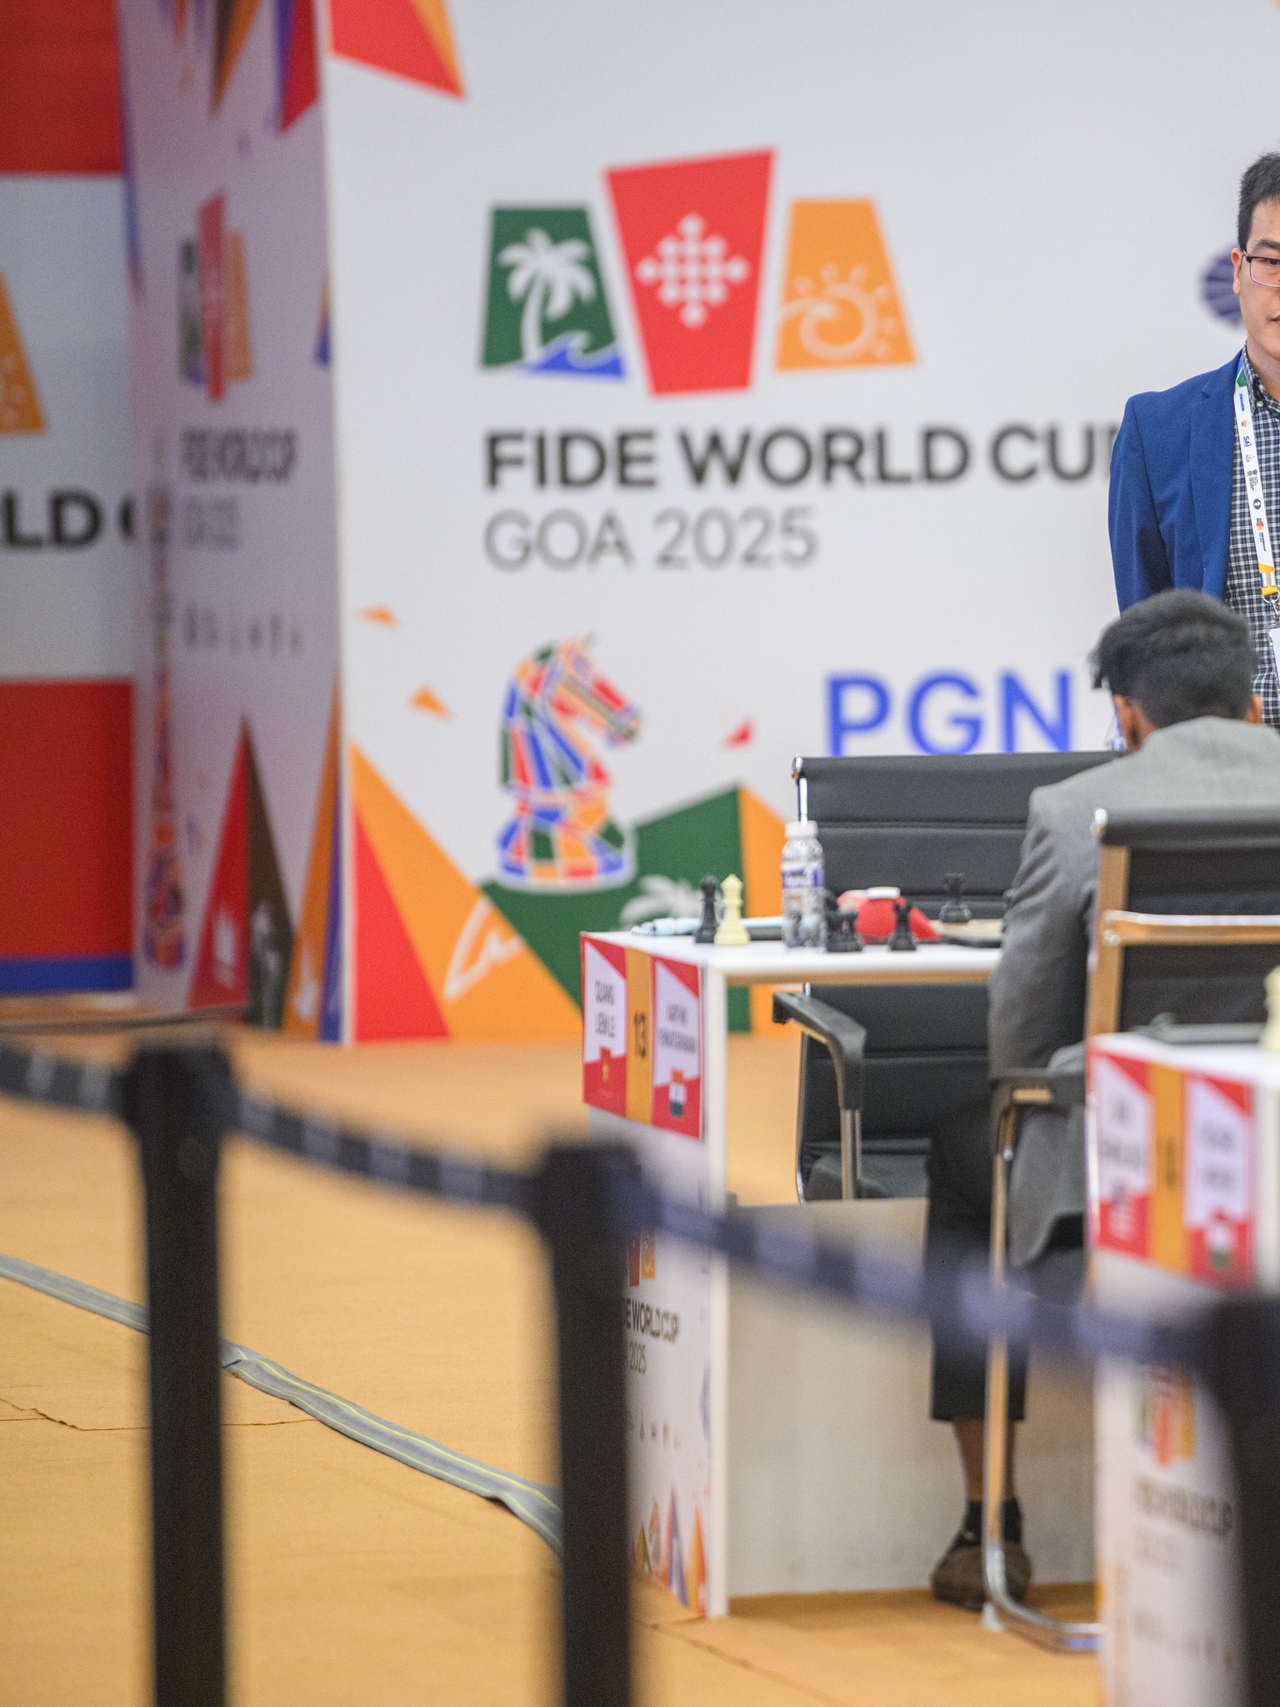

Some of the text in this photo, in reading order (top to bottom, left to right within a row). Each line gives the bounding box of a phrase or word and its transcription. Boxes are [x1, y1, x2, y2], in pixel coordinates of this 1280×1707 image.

[485, 429, 657, 489] FIDE
[677, 425, 971, 487] WORLD
[484, 505, 819, 572] GOA 2025
[826, 670, 1072, 757] PGN
[631, 1299, 660, 1337] WORLD
[629, 1340, 647, 1374] 2025
